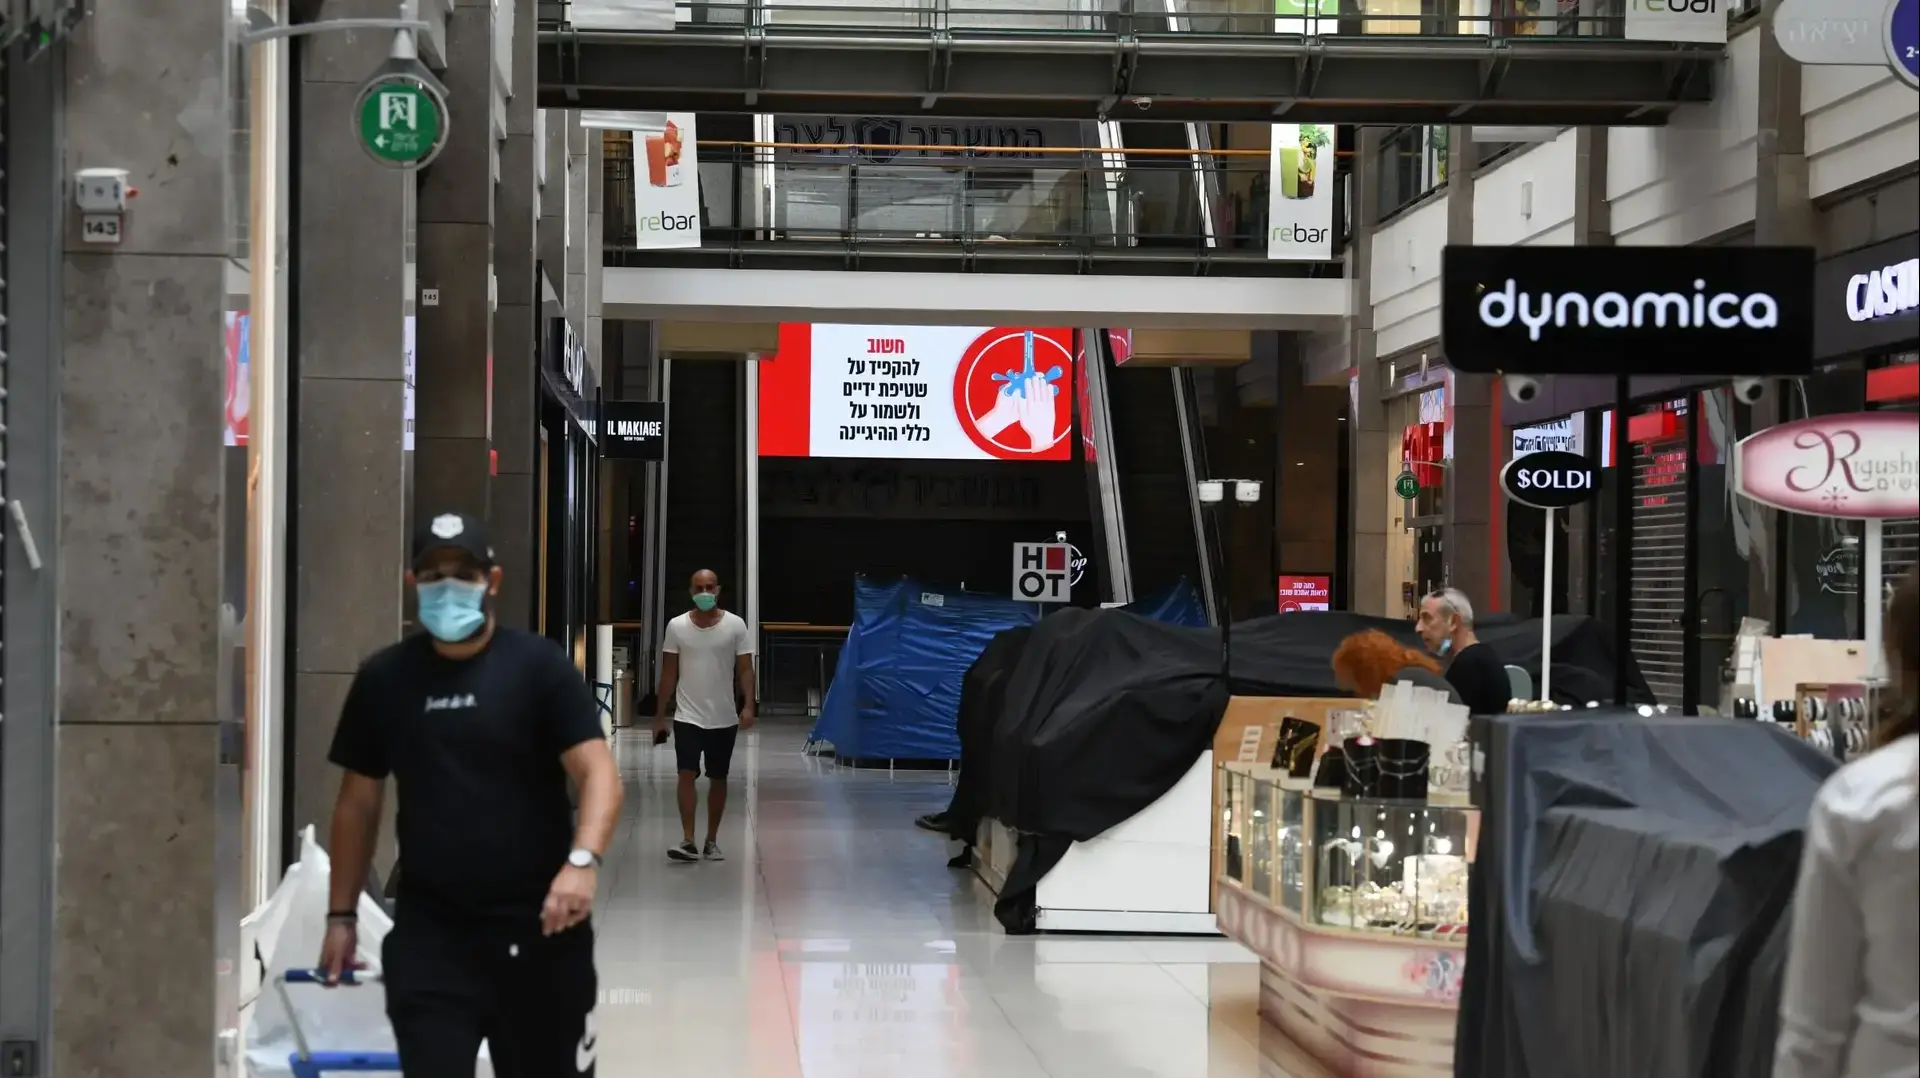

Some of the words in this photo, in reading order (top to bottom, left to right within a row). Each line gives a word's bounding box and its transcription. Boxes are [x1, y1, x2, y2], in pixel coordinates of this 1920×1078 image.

[908, 124, 1045, 158] המשביר
[86, 222, 118, 236] 143
[639, 210, 697, 231] rebar
[1272, 222, 1329, 243] rebar
[1478, 278, 1778, 342] dynamica
[867, 338, 905, 354] חשוב
[847, 357, 866, 375] על
[869, 358, 920, 379] להקפיד
[843, 381, 875, 397] ידיים
[878, 382, 928, 398] שטיפת
[849, 401, 868, 419] על
[871, 402, 920, 420] ולשמור
[607, 420, 616, 436] IL
[617, 420, 662, 436] MAKIAGE
[840, 425, 898, 441] ההיגיינה
[901, 424, 930, 441] כללי
